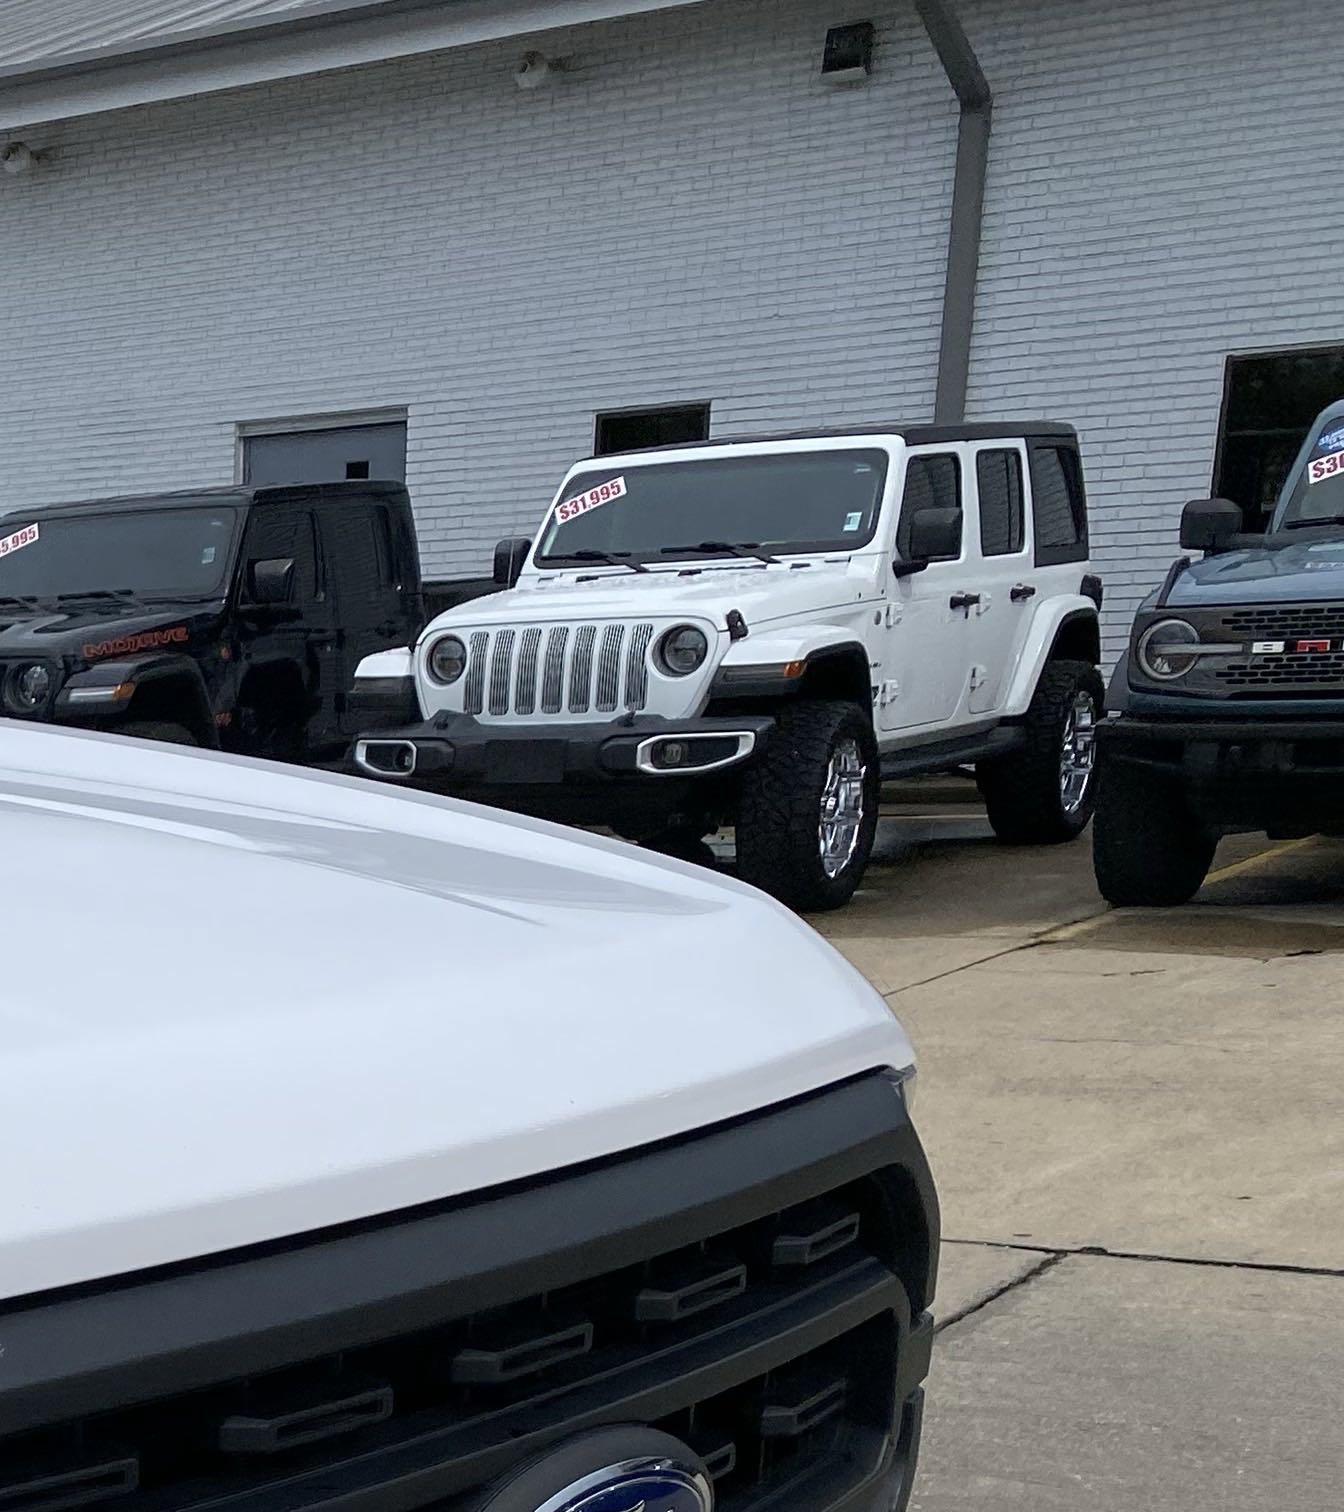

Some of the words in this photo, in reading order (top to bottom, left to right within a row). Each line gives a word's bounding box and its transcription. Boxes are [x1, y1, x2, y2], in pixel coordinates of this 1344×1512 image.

[559, 480, 621, 520] $31,995
[83, 625, 190, 658] MOJAVE
[1252, 640, 1344, 655] BR
